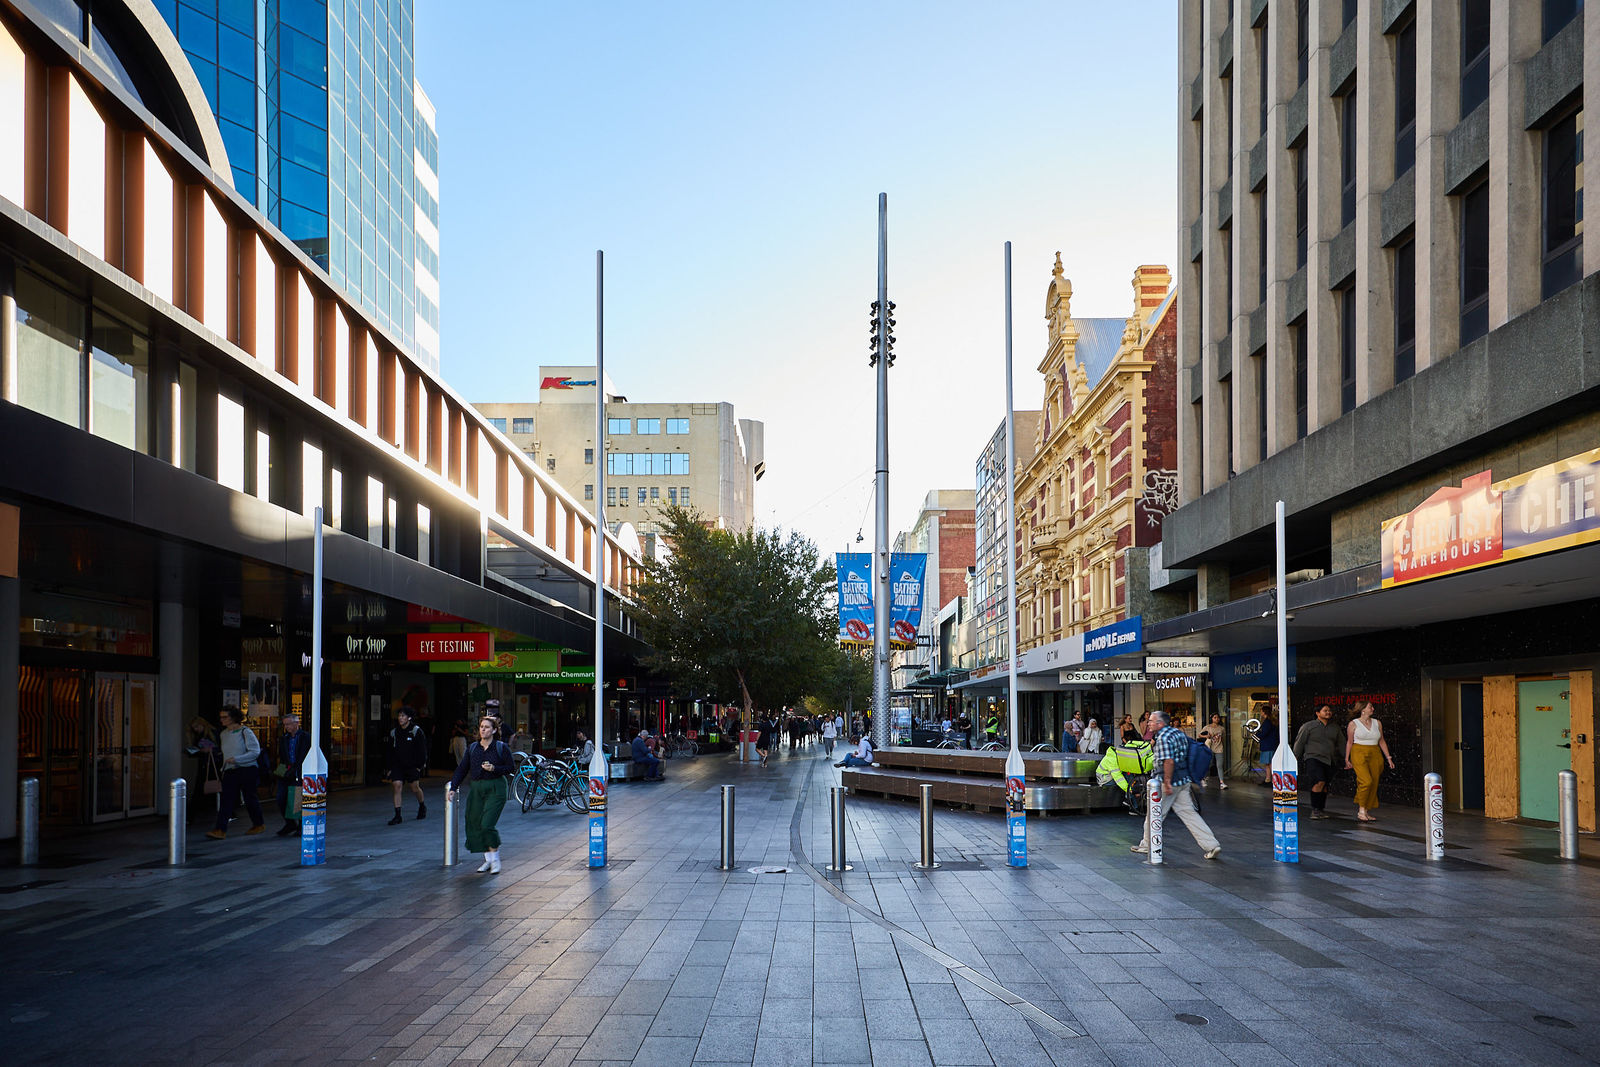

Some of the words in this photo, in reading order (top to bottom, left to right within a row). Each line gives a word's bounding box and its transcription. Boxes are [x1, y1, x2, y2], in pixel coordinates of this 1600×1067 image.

[1400, 502, 1496, 555] CHEMIST
[1399, 536, 1493, 572] WAREHOUSE
[842, 582, 868, 594] GATHER
[893, 582, 920, 595] GATHER
[843, 594, 869, 605] ROUND
[894, 594, 919, 606] ROUND
[346, 635, 363, 654] OPT
[366, 635, 387, 654] SHOP
[1117, 631, 1136, 645] REPAIR
[420, 640, 435, 653] EYE
[439, 640, 475, 653] TESTING
[1156, 661, 1188, 669] MOBILE
[1314, 695, 1345, 706] STUDENT
[1345, 693, 1397, 705] APARTMENTS
